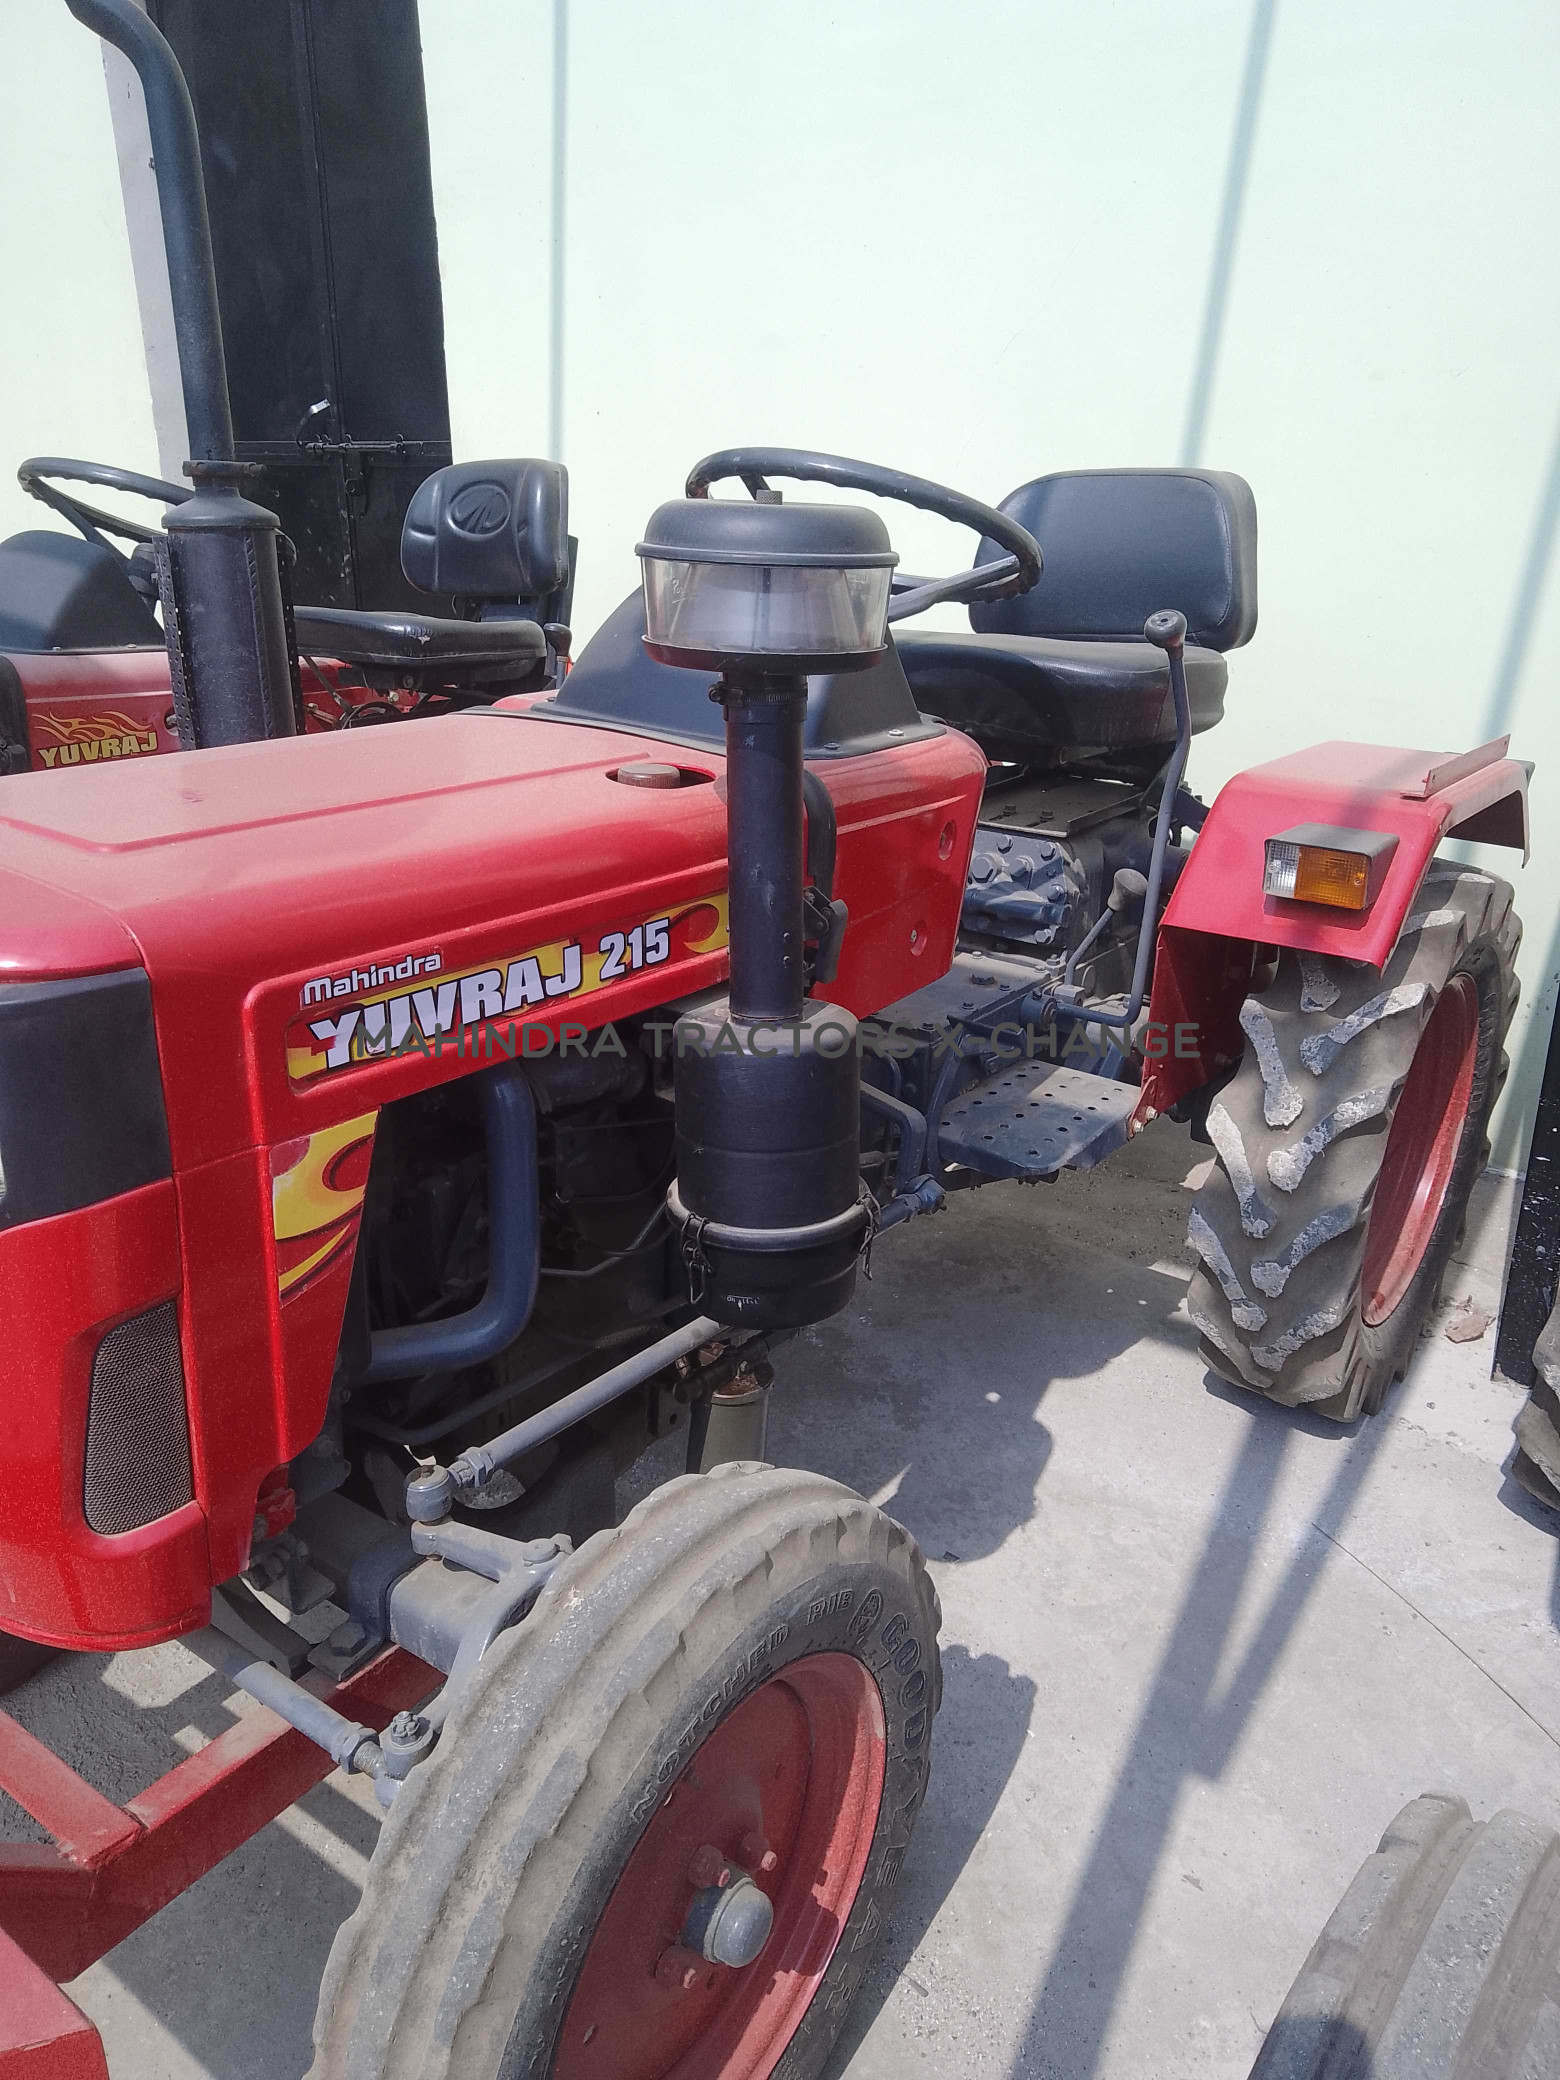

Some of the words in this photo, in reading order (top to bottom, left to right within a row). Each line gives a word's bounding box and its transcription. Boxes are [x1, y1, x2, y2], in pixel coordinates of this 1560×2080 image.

[38, 732, 158, 768] YUVRAJ
[303, 953, 442, 1006] Mahindra
[308, 943, 582, 1070] YUVRAJ
[598, 916, 670, 980] 215
